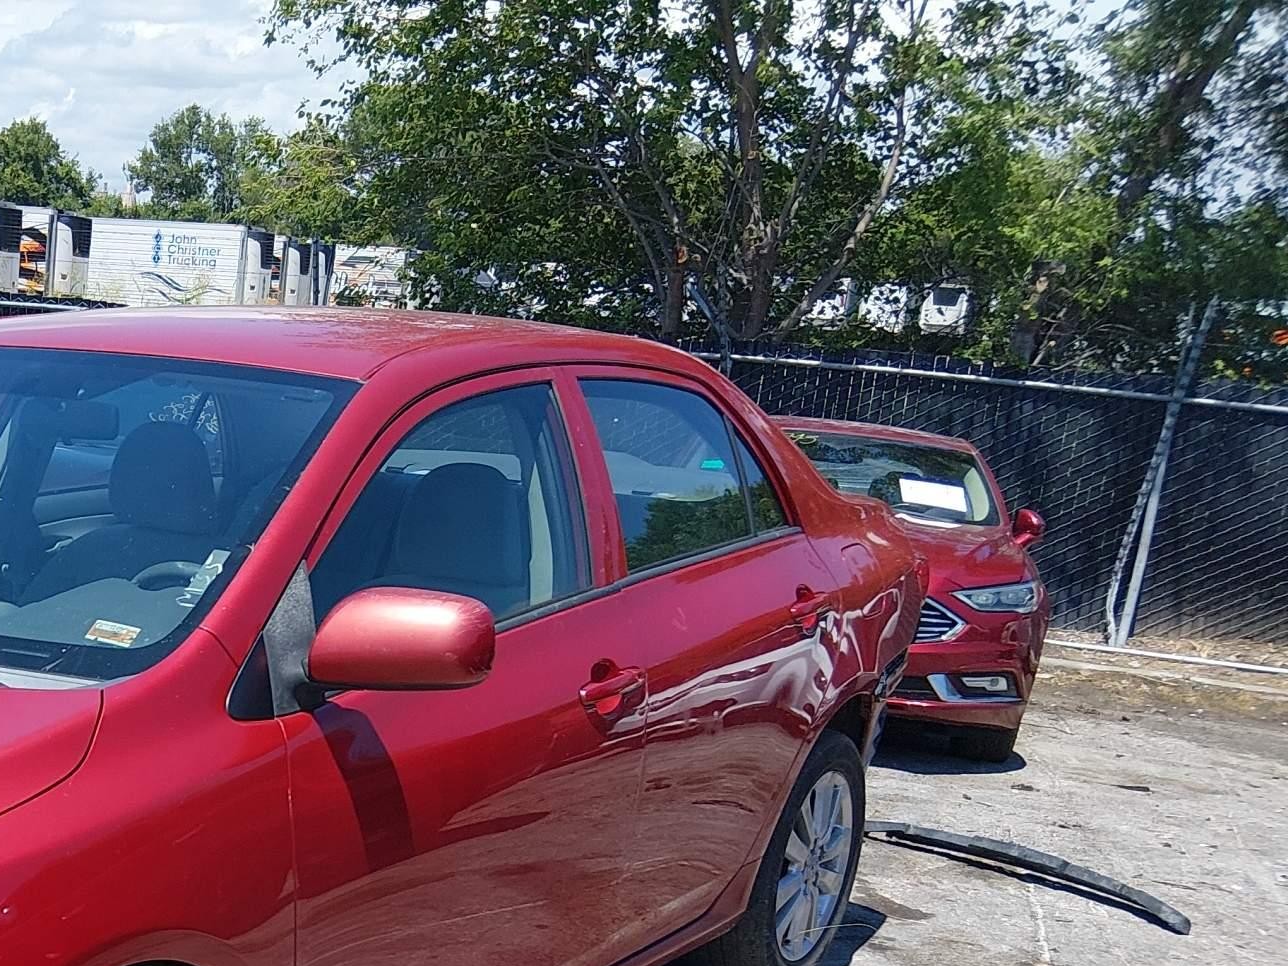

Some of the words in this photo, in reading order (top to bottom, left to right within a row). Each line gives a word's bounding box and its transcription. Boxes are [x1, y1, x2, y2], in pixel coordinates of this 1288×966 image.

[168, 233, 197, 245] John
[167, 244, 221, 257] Christner
[168, 255, 217, 269] Trucking
